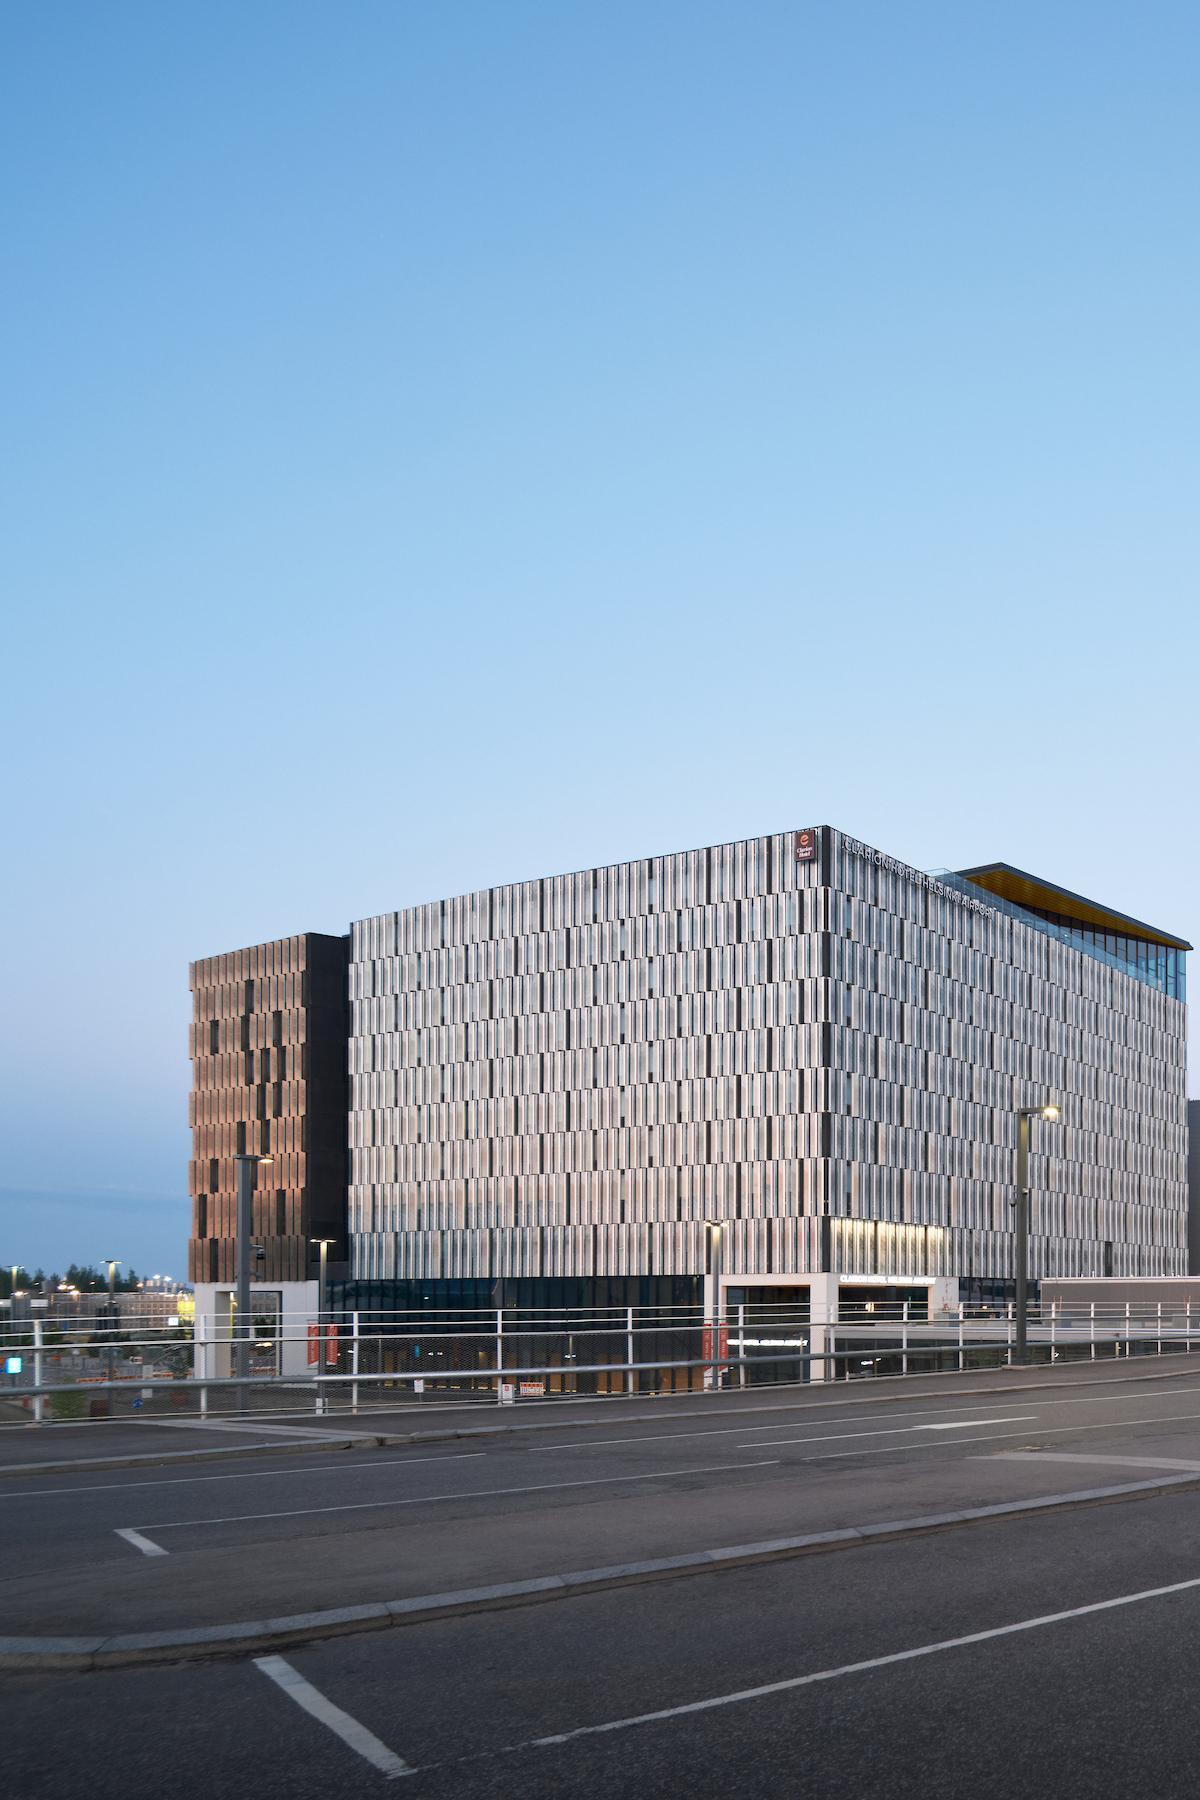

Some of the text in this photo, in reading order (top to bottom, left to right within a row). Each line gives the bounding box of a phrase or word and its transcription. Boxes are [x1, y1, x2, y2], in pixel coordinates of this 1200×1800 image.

[844, 838, 889, 869] CLARION
[891, 862, 922, 885] HOTEL
[923, 876, 962, 902] HELSINKI
